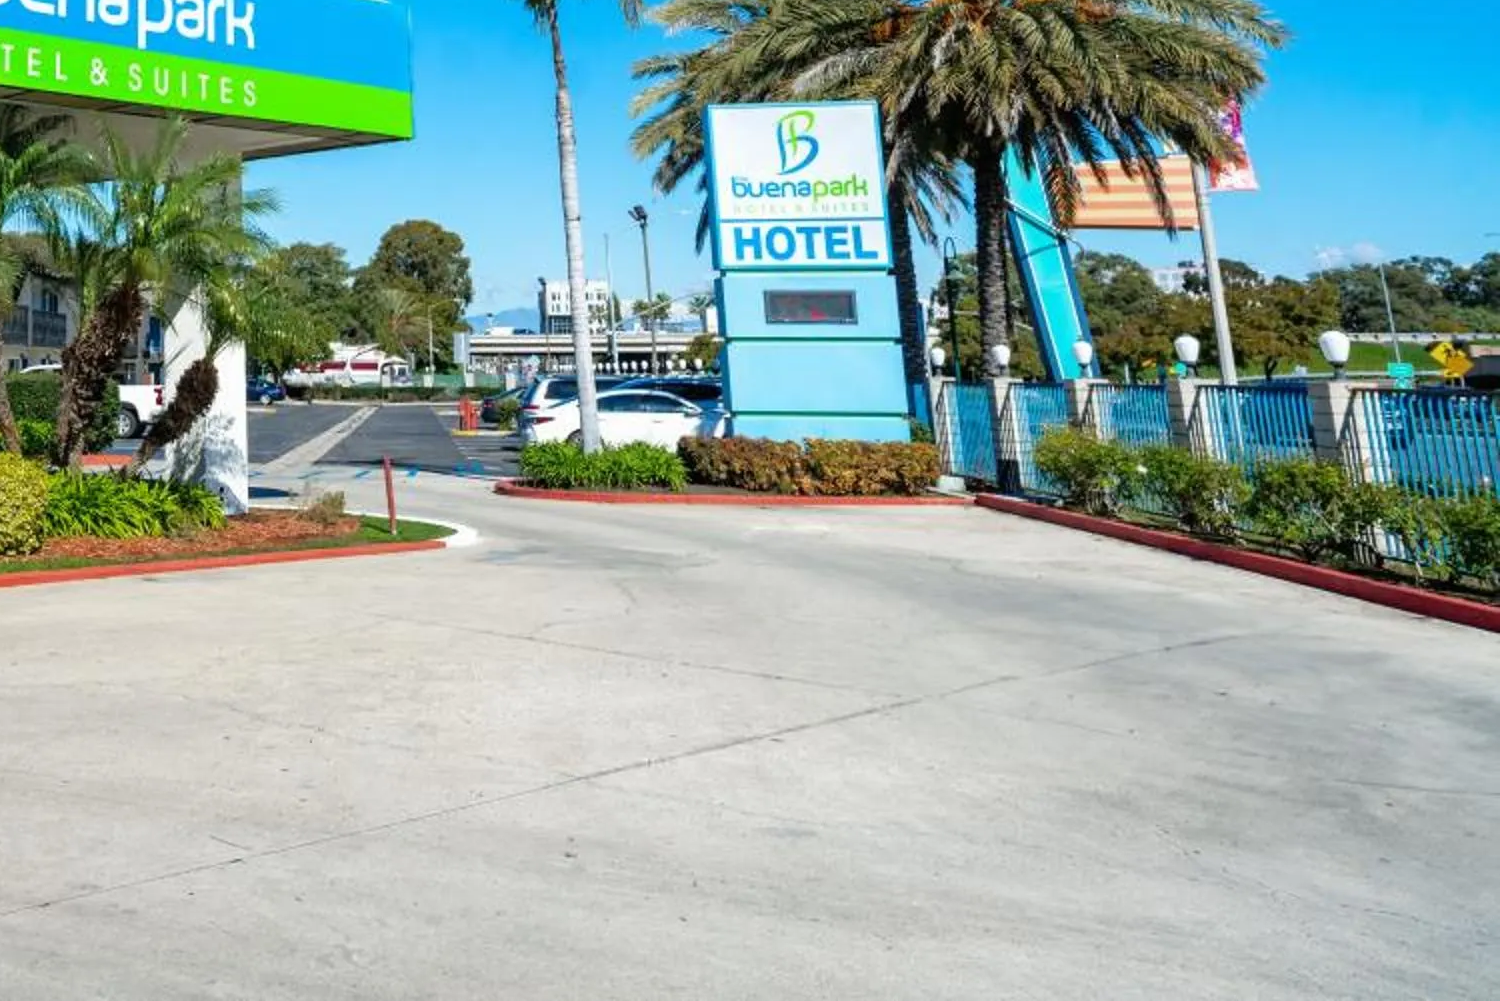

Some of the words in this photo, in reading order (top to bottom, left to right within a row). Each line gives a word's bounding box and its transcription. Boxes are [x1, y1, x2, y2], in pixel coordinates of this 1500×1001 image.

[90, 57, 109, 87] &
[128, 63, 258, 108] SUITES
[733, 225, 879, 261] HOTEL
